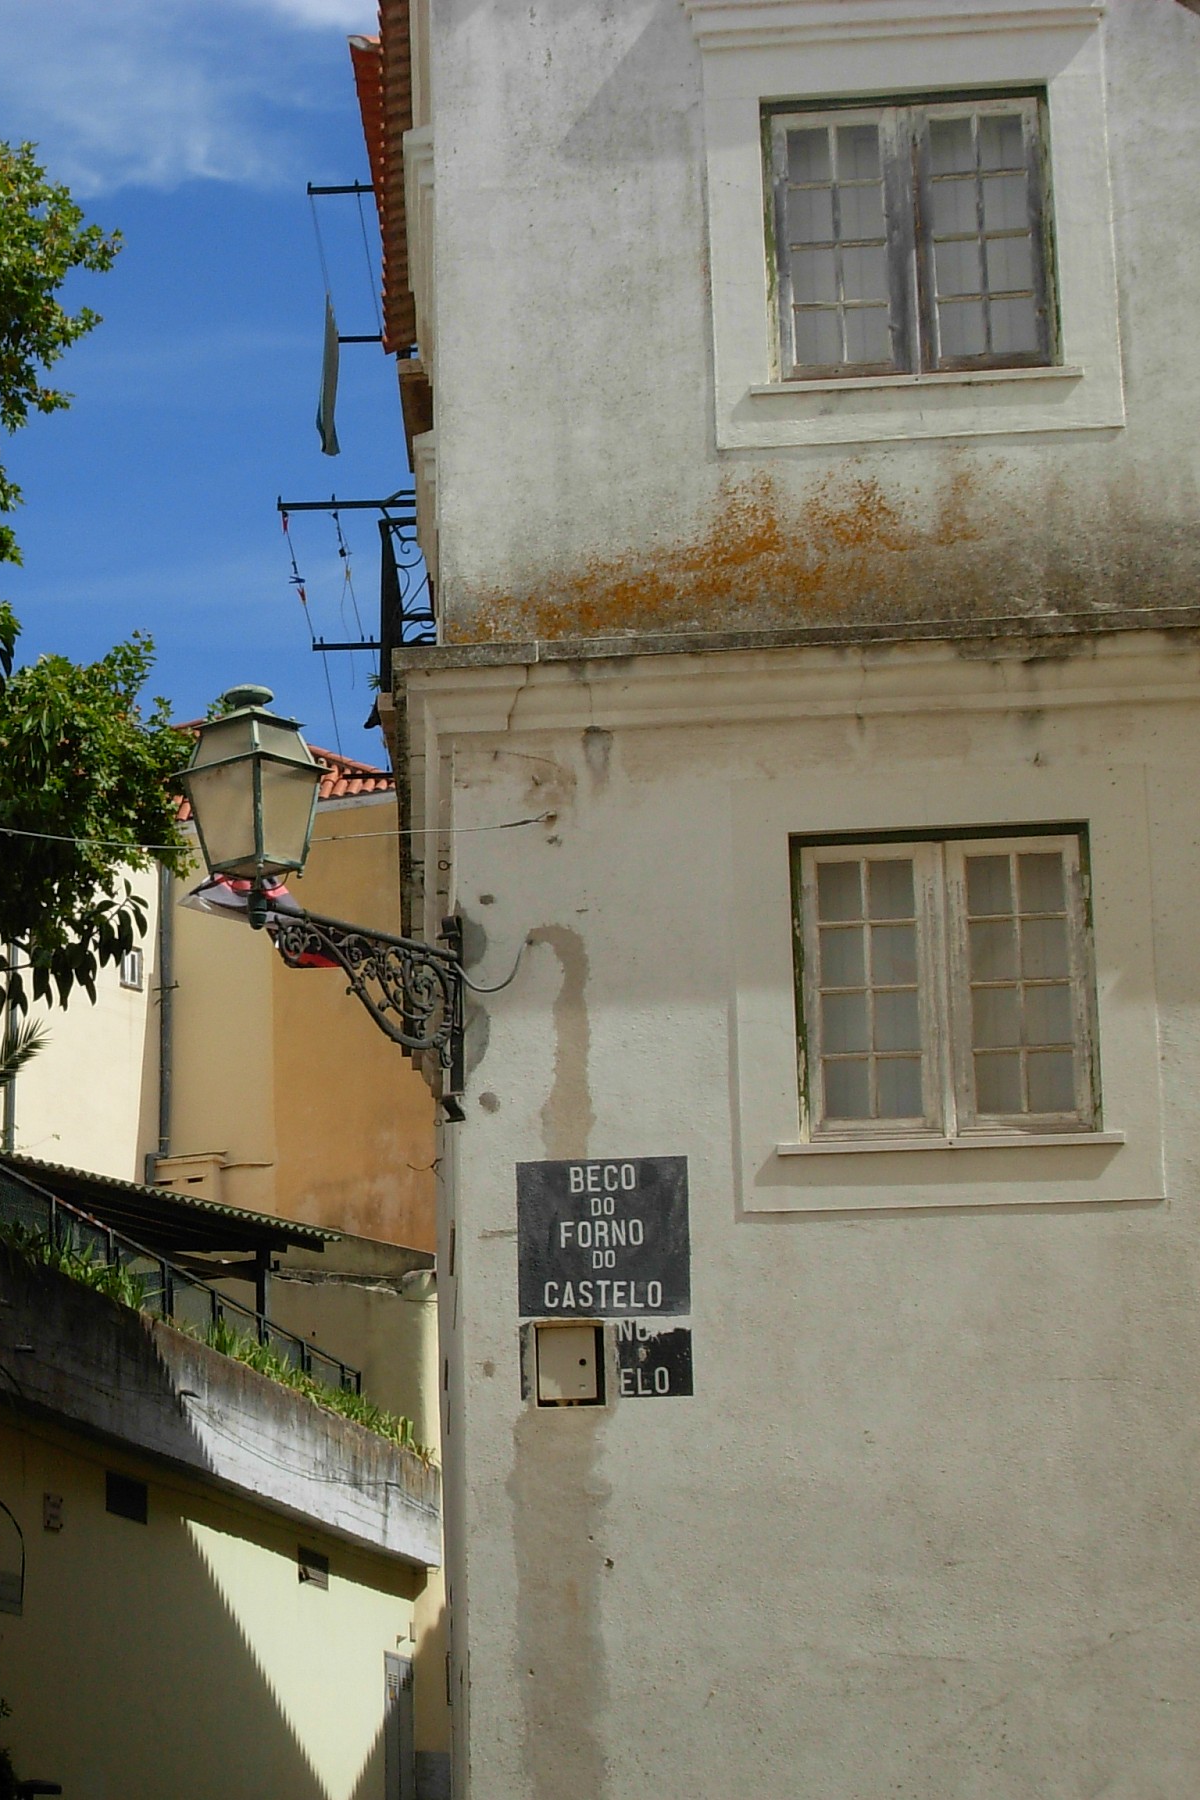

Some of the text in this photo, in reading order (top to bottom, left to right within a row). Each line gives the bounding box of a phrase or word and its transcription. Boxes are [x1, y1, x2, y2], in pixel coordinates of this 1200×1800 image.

[569, 1163, 636, 1194] BECO
[590, 1197, 615, 1217] DO
[559, 1219, 644, 1249] FORNO
[592, 1250, 616, 1269] DO
[544, 1280, 663, 1309] CASTELO
